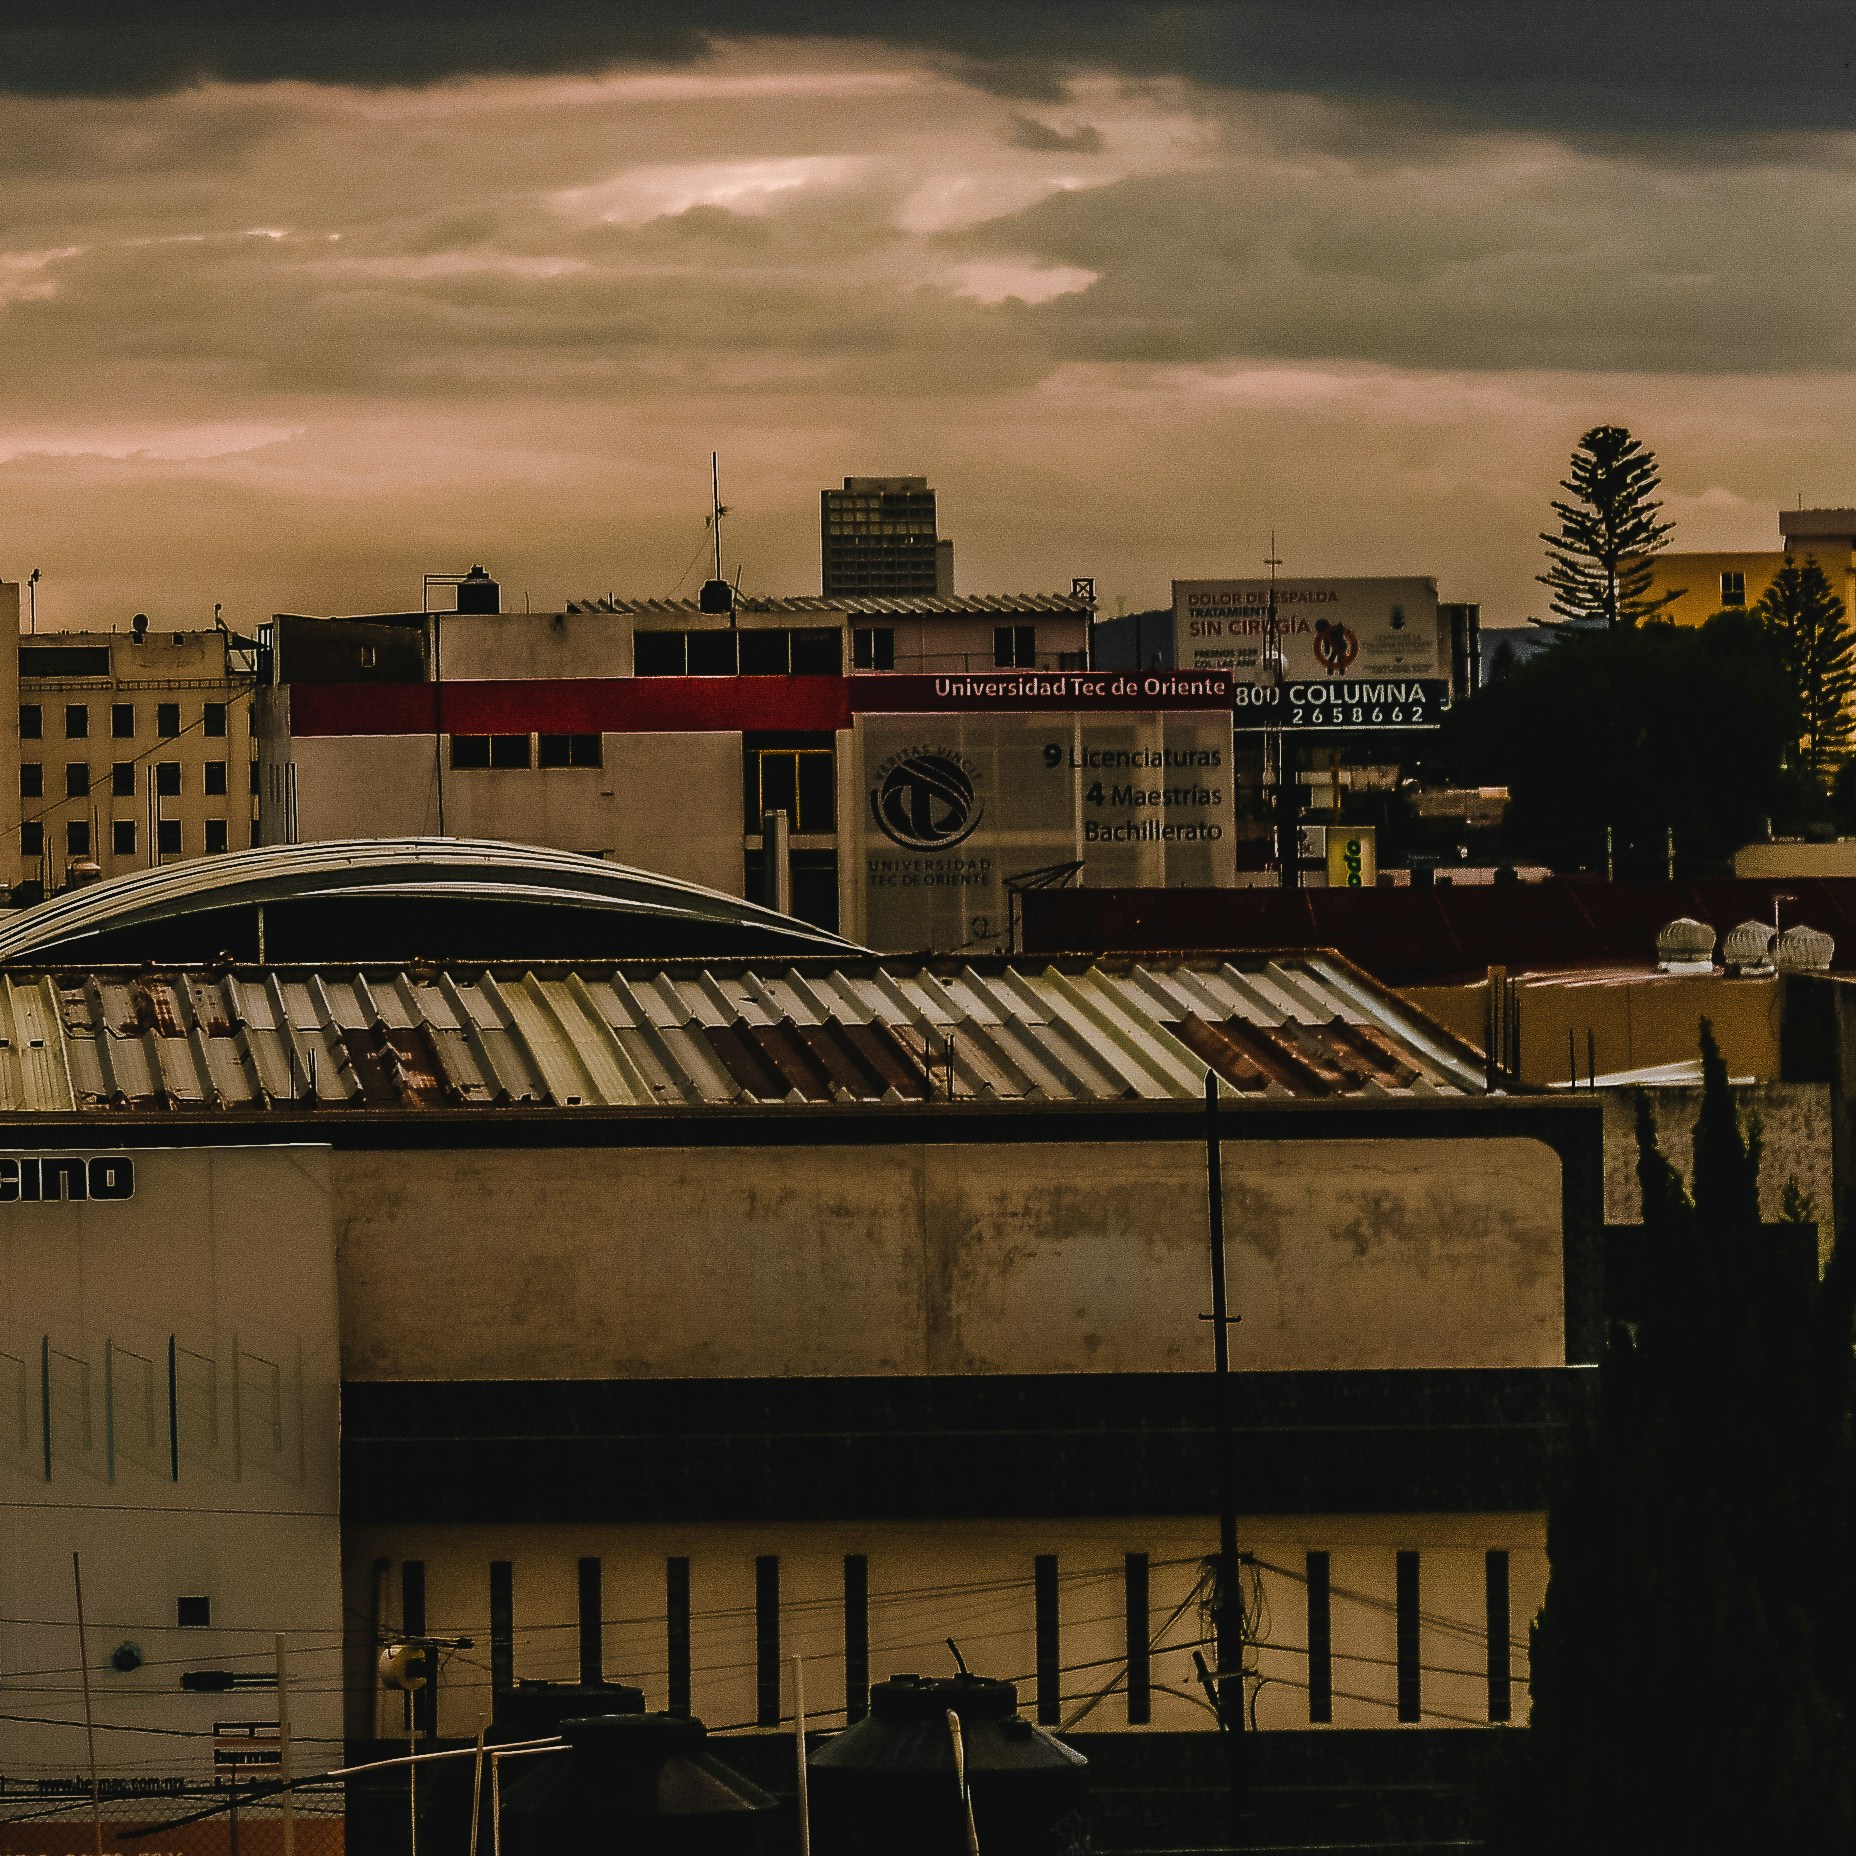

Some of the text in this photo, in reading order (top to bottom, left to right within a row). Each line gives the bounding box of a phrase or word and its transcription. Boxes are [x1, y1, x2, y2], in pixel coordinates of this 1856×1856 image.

[1187, 593, 1242, 606] DOLOR
[1245, 592, 1266, 605] DE
[1189, 620, 1222, 636] SIN
[935, 676, 1226, 698] Universidad Tec de Oriente
[1289, 683, 1426, 705] COLUMNA
[1043, 743, 1222, 769] 9 Licenciaturas
[1086, 783, 1223, 807] 4 Maestrías
[1085, 819, 1223, 843] Bachillerato
[868, 858, 991, 872] UNIVERSIDAD
[870, 873, 990, 887] TEC DE ORIENTE
